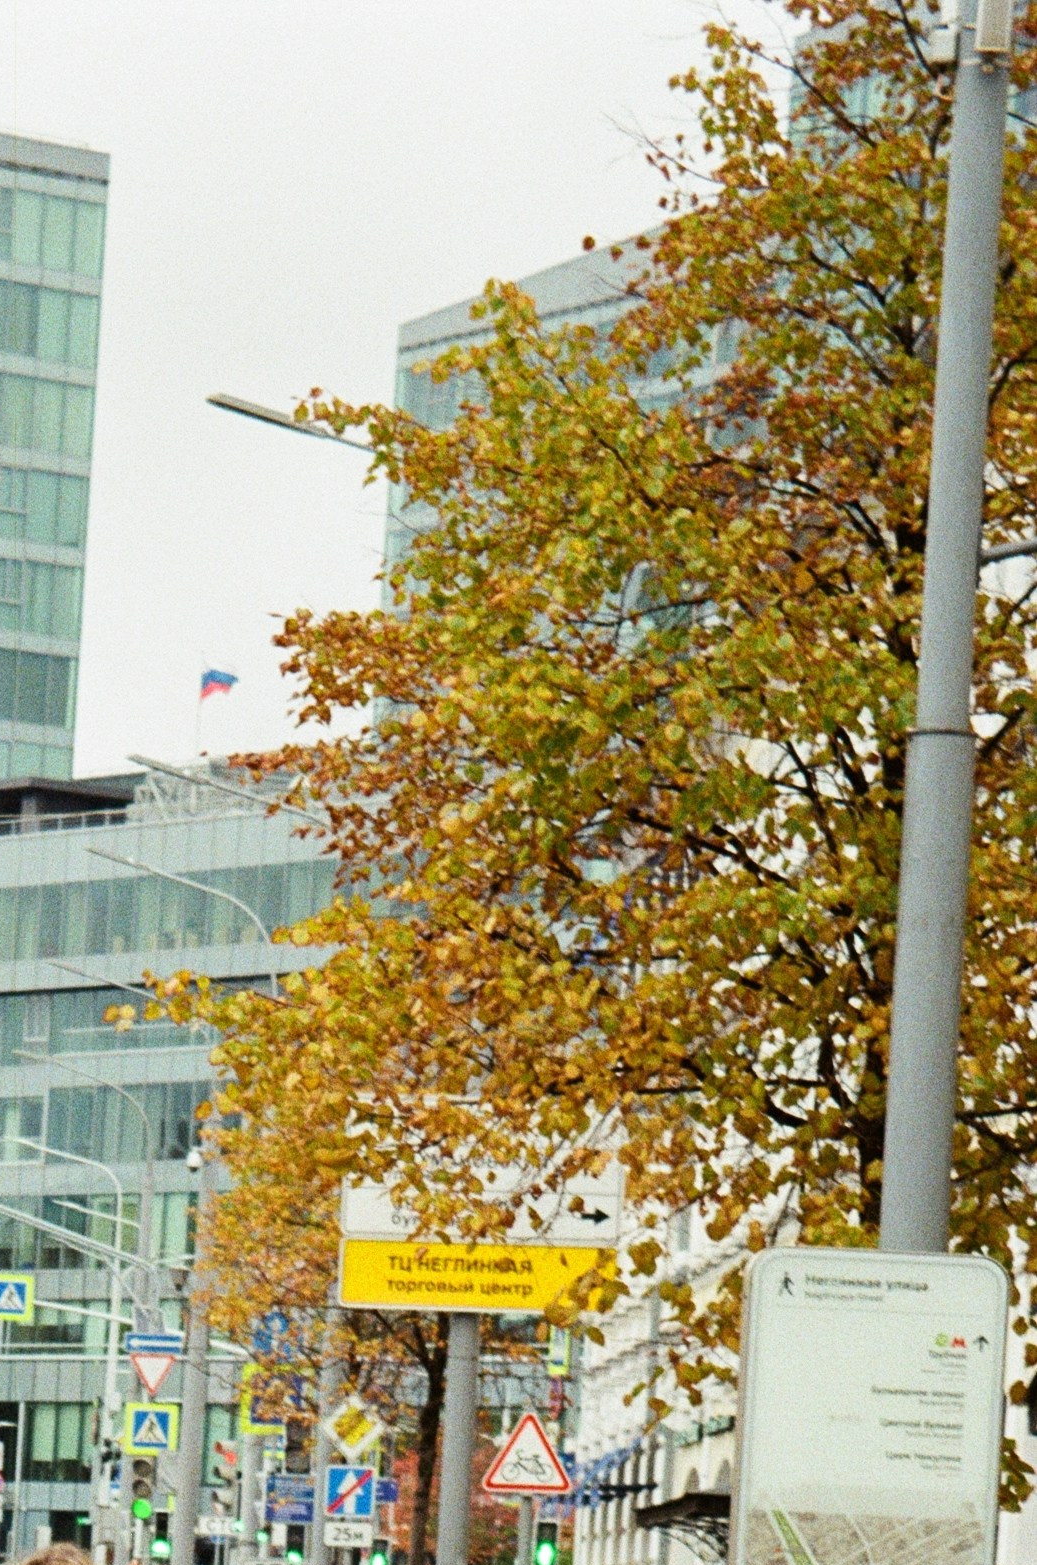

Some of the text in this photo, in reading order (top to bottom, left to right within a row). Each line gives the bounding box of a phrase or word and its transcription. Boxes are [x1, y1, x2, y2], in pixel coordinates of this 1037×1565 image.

[389, 1255, 412, 1272] ТЦ
[387, 1279, 534, 1297] торговый центр
